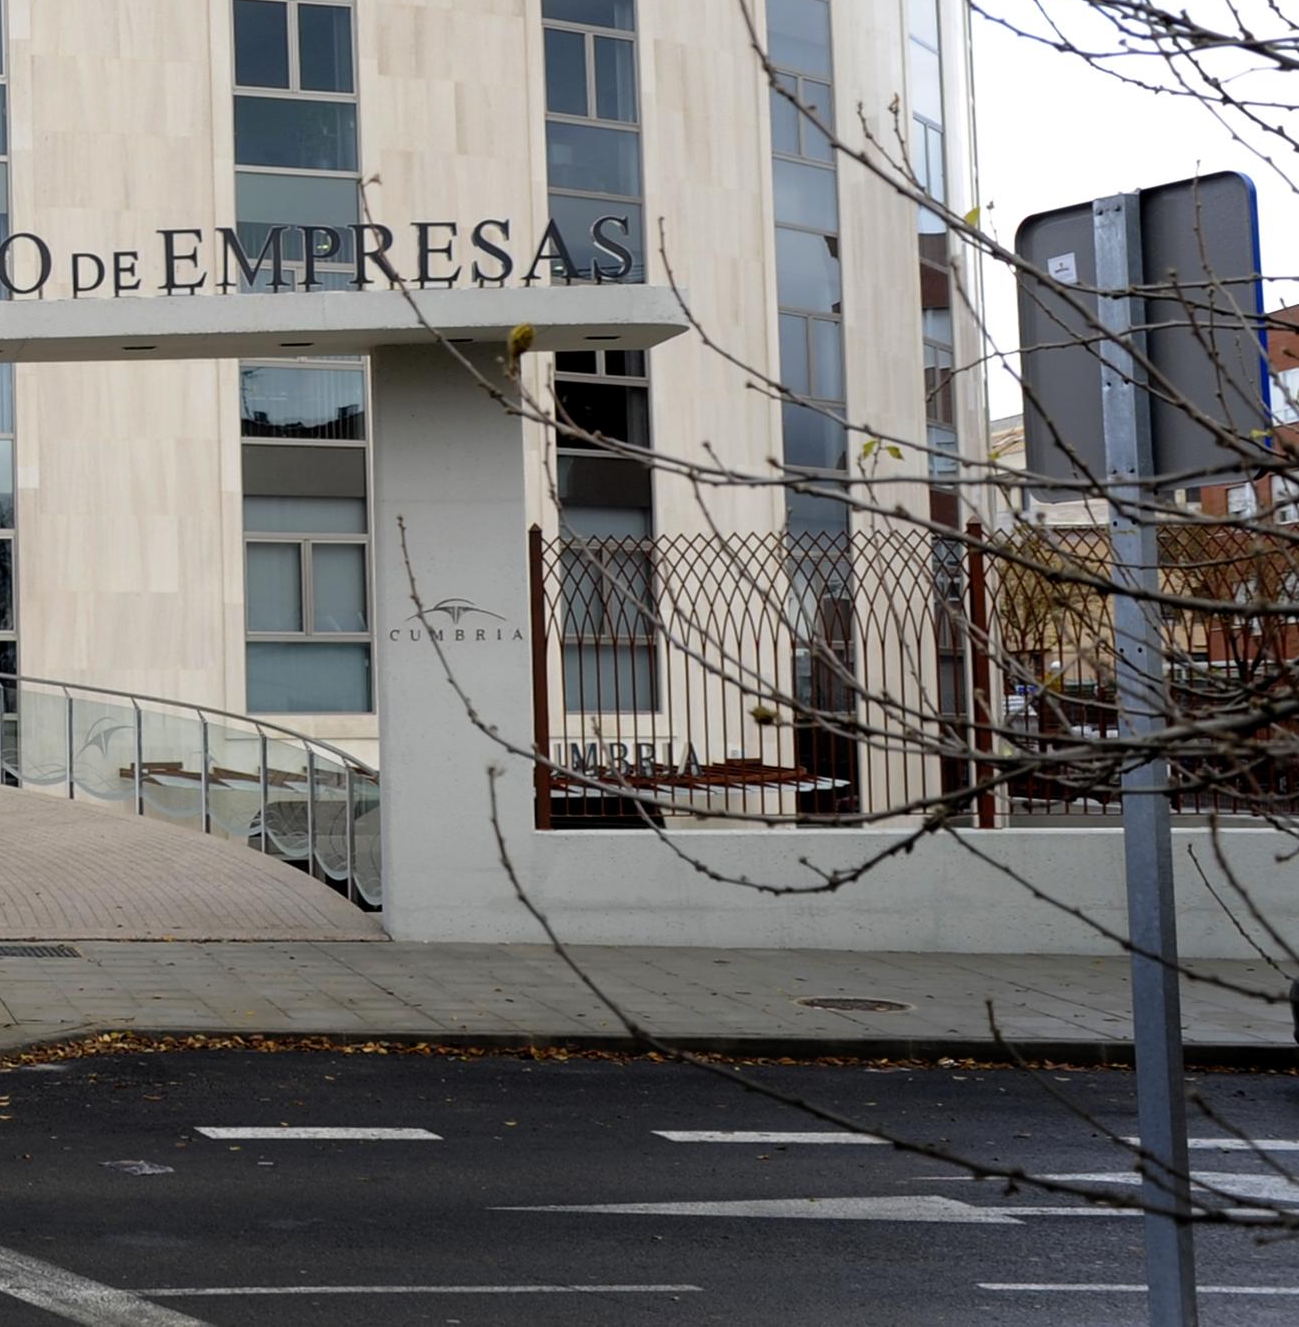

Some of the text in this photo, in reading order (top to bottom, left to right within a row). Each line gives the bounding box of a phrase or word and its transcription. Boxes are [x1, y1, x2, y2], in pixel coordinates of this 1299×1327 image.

[72, 250, 142, 293] DE
[155, 215, 634, 290] EMPRESAS
[389, 628, 524, 642] CUMBRIA
